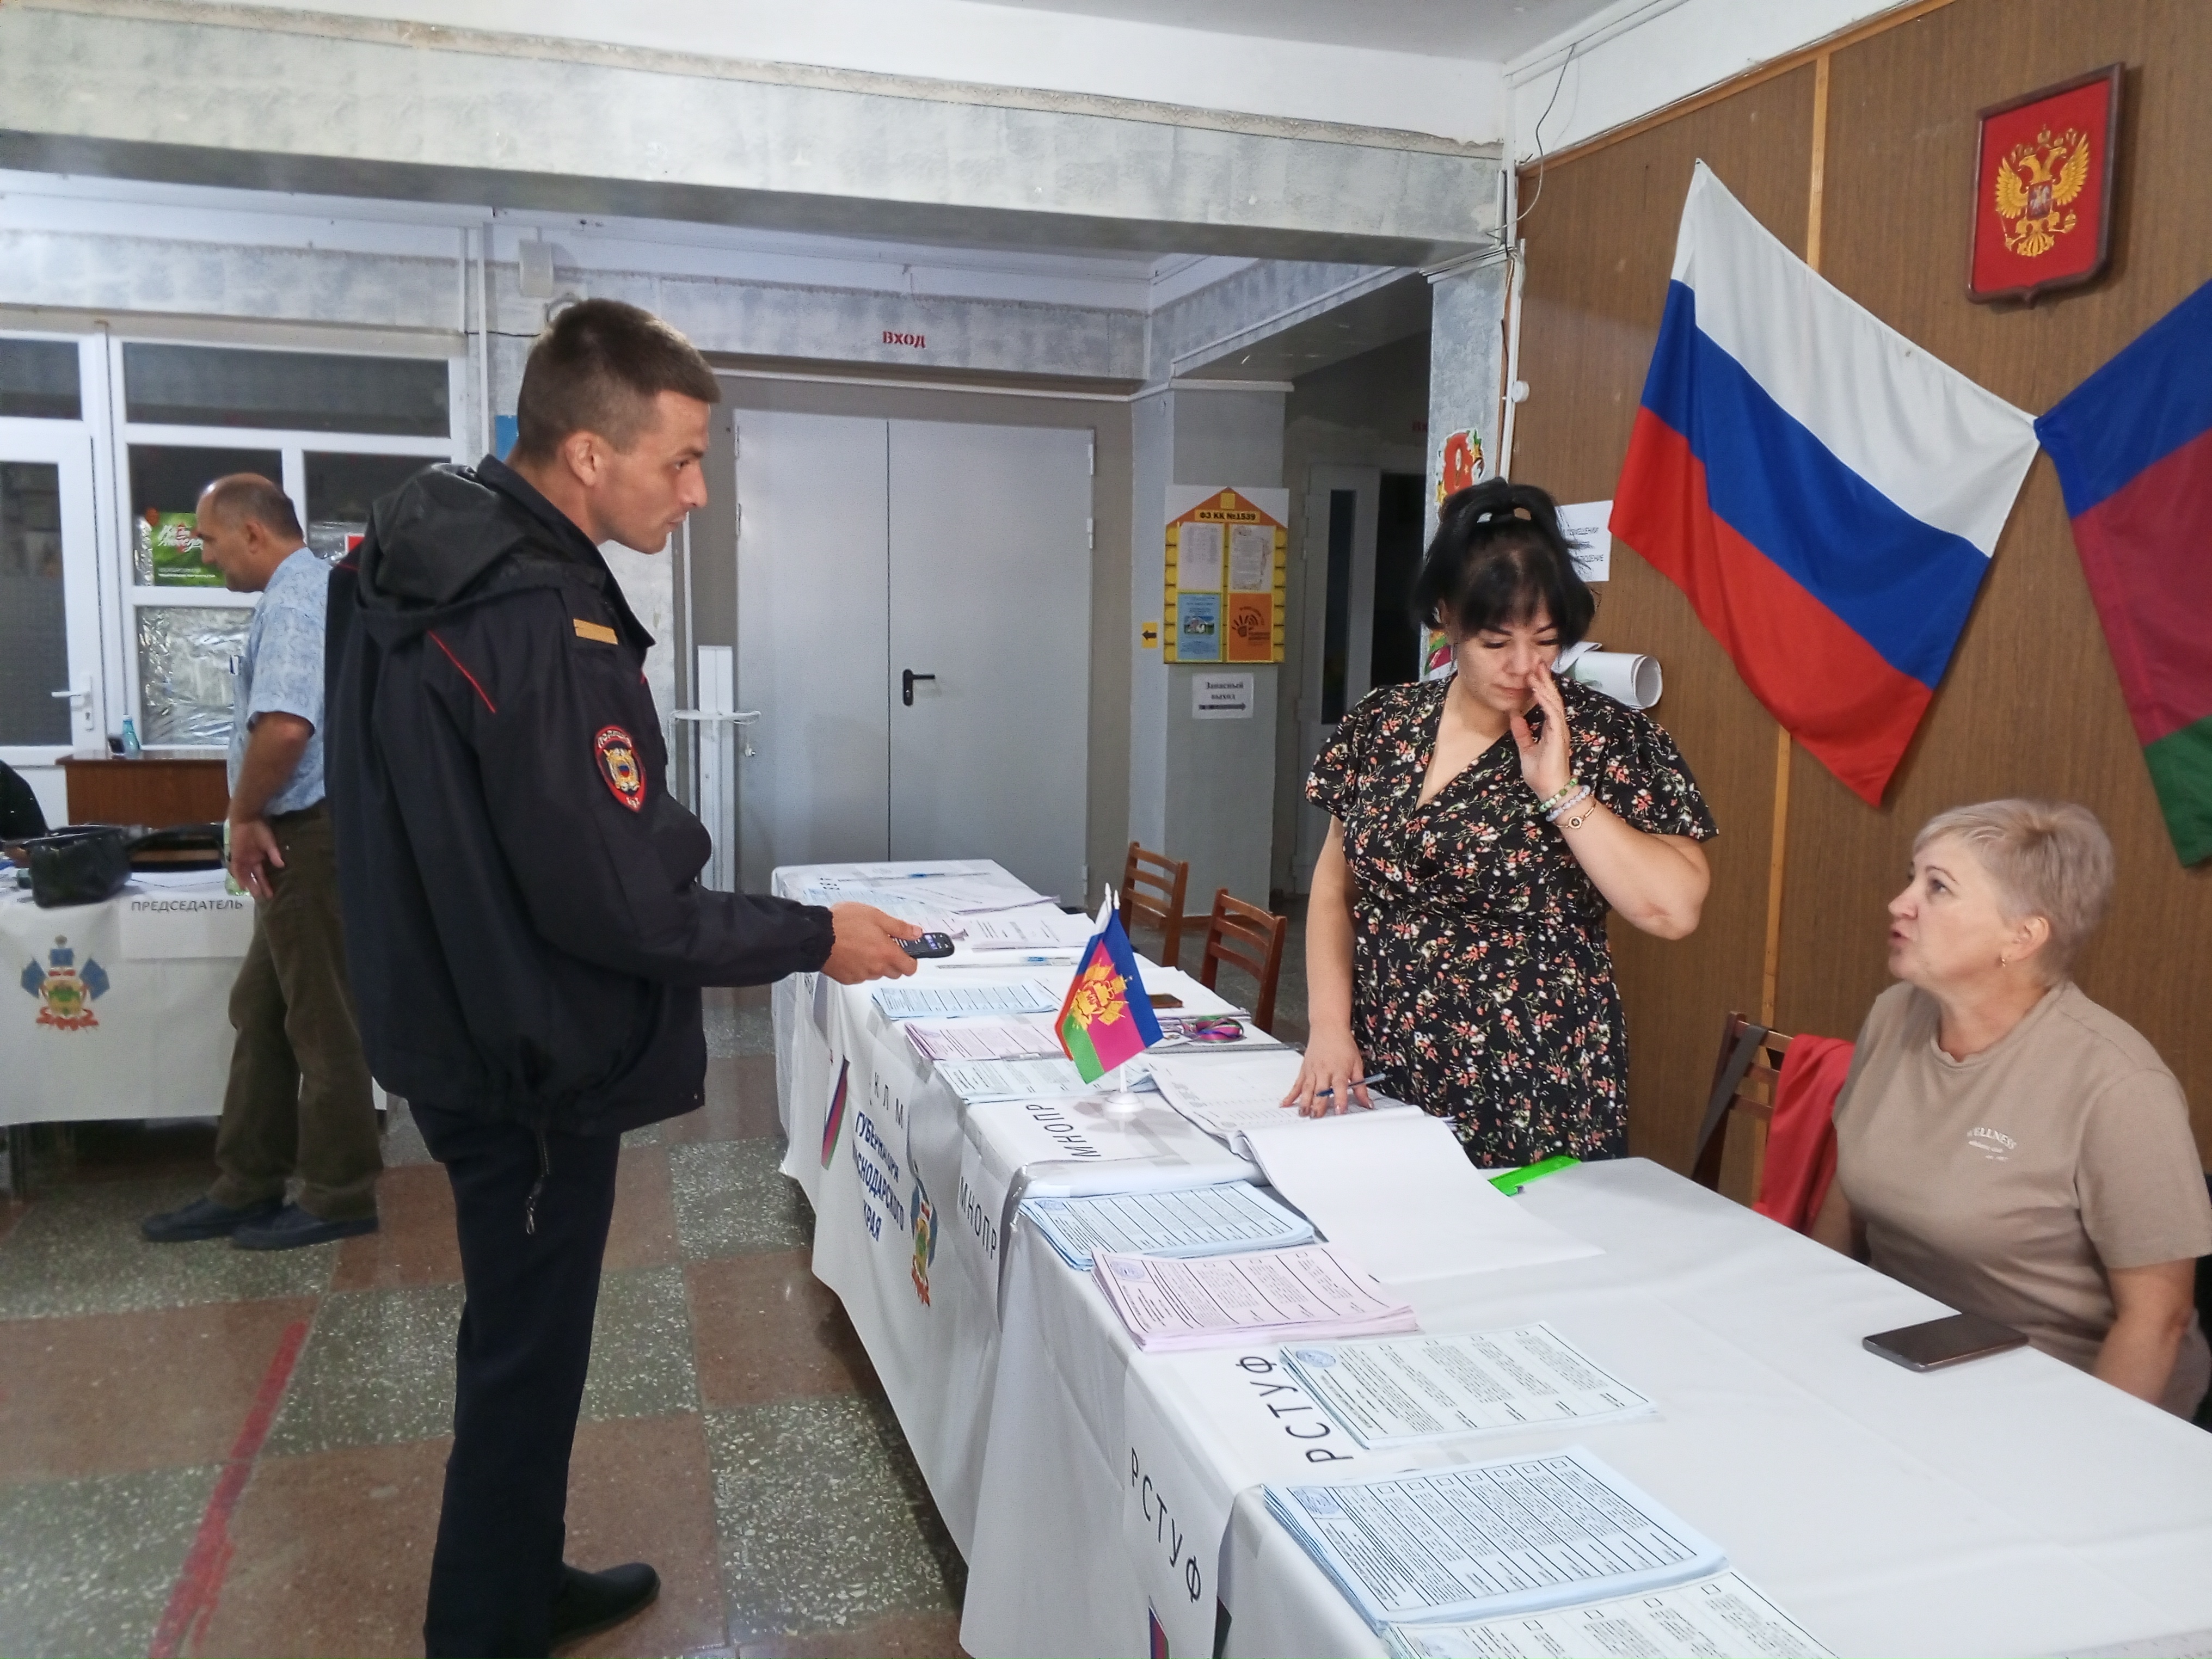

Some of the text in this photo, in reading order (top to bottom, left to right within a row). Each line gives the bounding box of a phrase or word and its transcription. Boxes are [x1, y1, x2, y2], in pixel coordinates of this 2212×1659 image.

[131, 900, 243, 913] ПРЕДСЕДАТЕЛЬ
[1026, 1104, 1101, 1157] МНОПР
[960, 1176, 997, 1260] МНОПР
[1236, 1356, 1354, 1463] РСТУФ
[1132, 1447, 1202, 1603] РСТУФ
